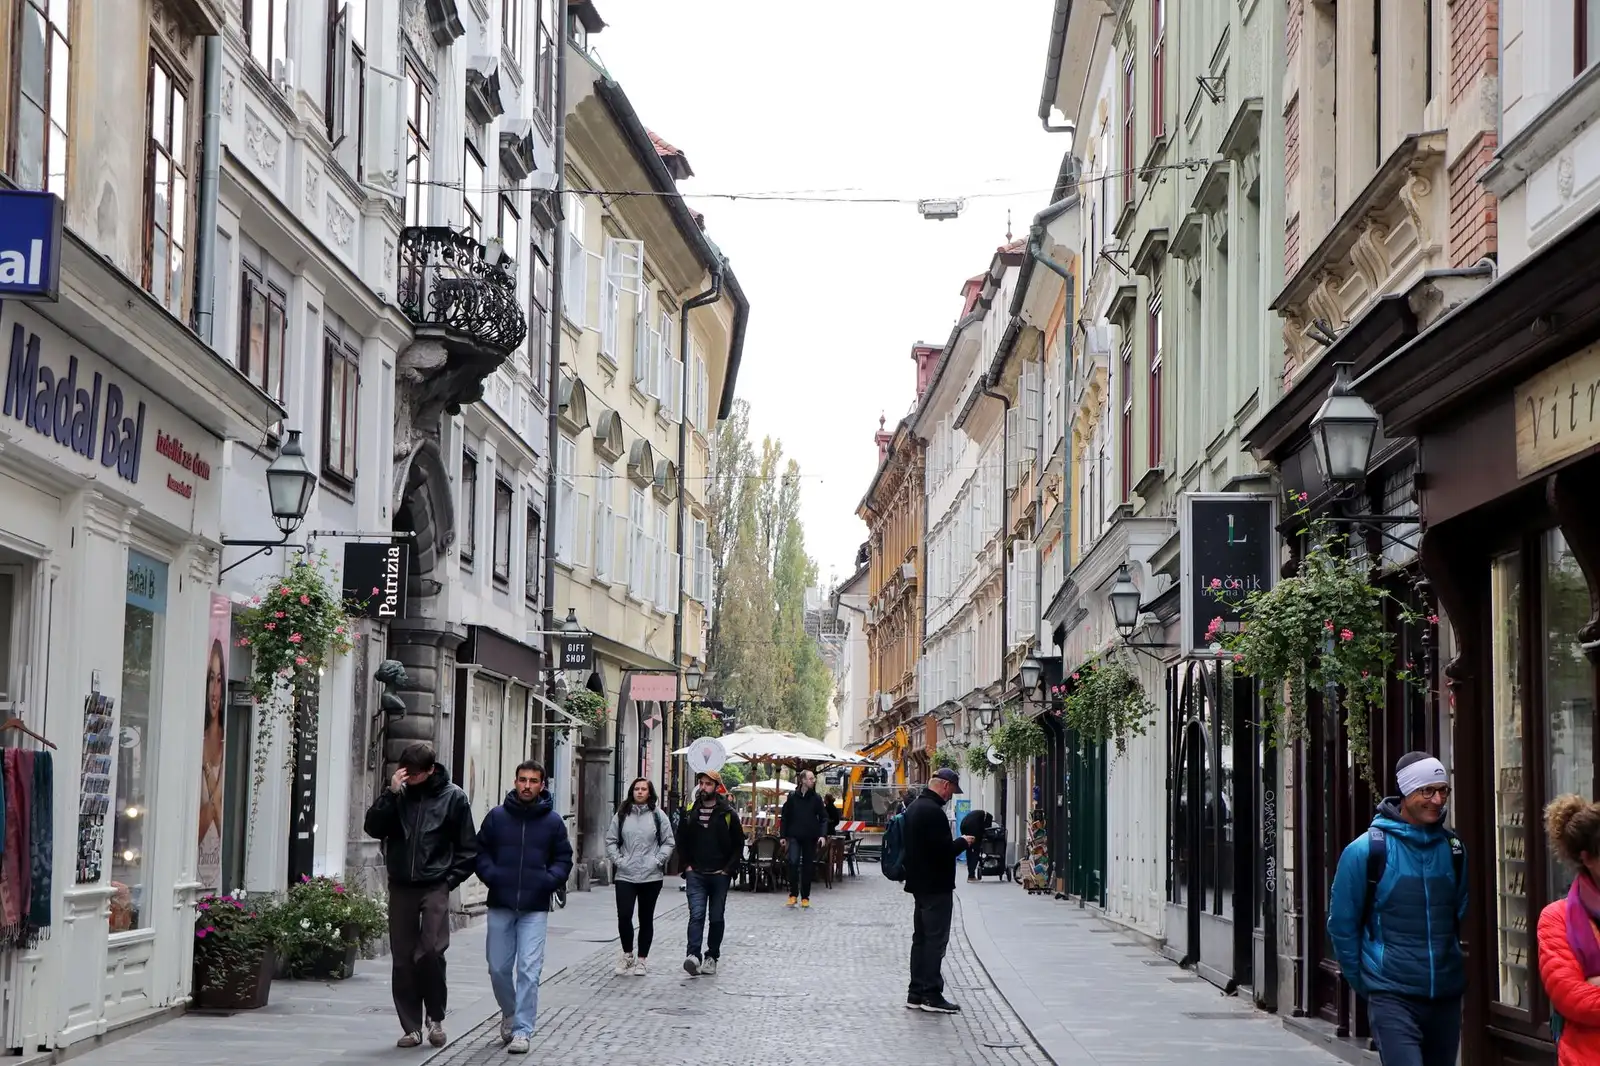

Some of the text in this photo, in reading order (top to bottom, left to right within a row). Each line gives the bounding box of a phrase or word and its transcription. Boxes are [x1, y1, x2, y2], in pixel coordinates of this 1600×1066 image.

[0, 239, 43, 285] al
[3, 322, 146, 484] Madal Bal
[1525, 379, 1600, 448] Vitr
[192, 452, 211, 481] dom
[379, 546, 400, 617] Patrizia
[565, 654, 586, 663] SHOP
[567, 643, 585, 652] GIFT
